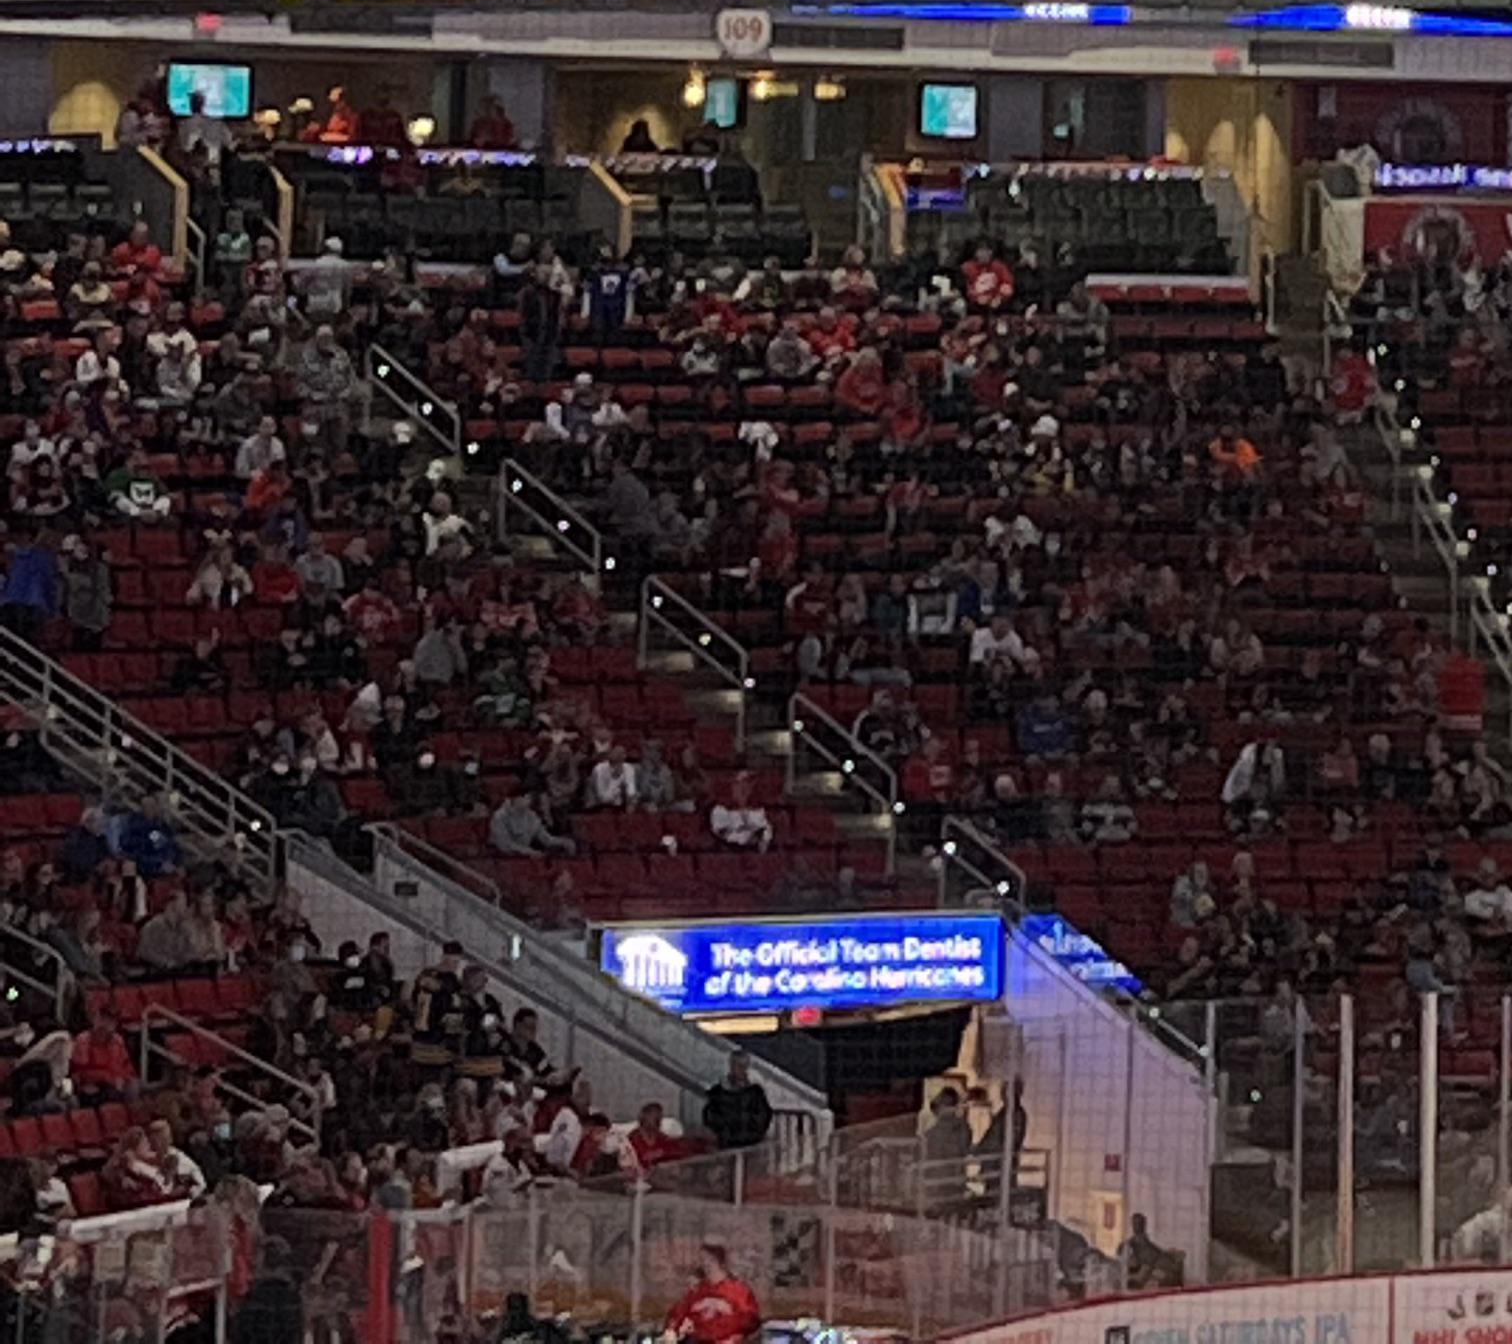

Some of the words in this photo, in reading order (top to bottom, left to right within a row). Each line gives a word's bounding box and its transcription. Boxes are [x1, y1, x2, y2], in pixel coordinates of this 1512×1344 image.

[724, 16, 763, 42] 109
[711, 943, 756, 969] The
[757, 940, 839, 966] Official
[841, 938, 900, 964] Team
[903, 935, 982, 962] Dentist
[704, 973, 731, 998] of
[734, 970, 771, 995] the
[773, 967, 868, 993] Carolina
[869, 965, 985, 989] Hurricanes
